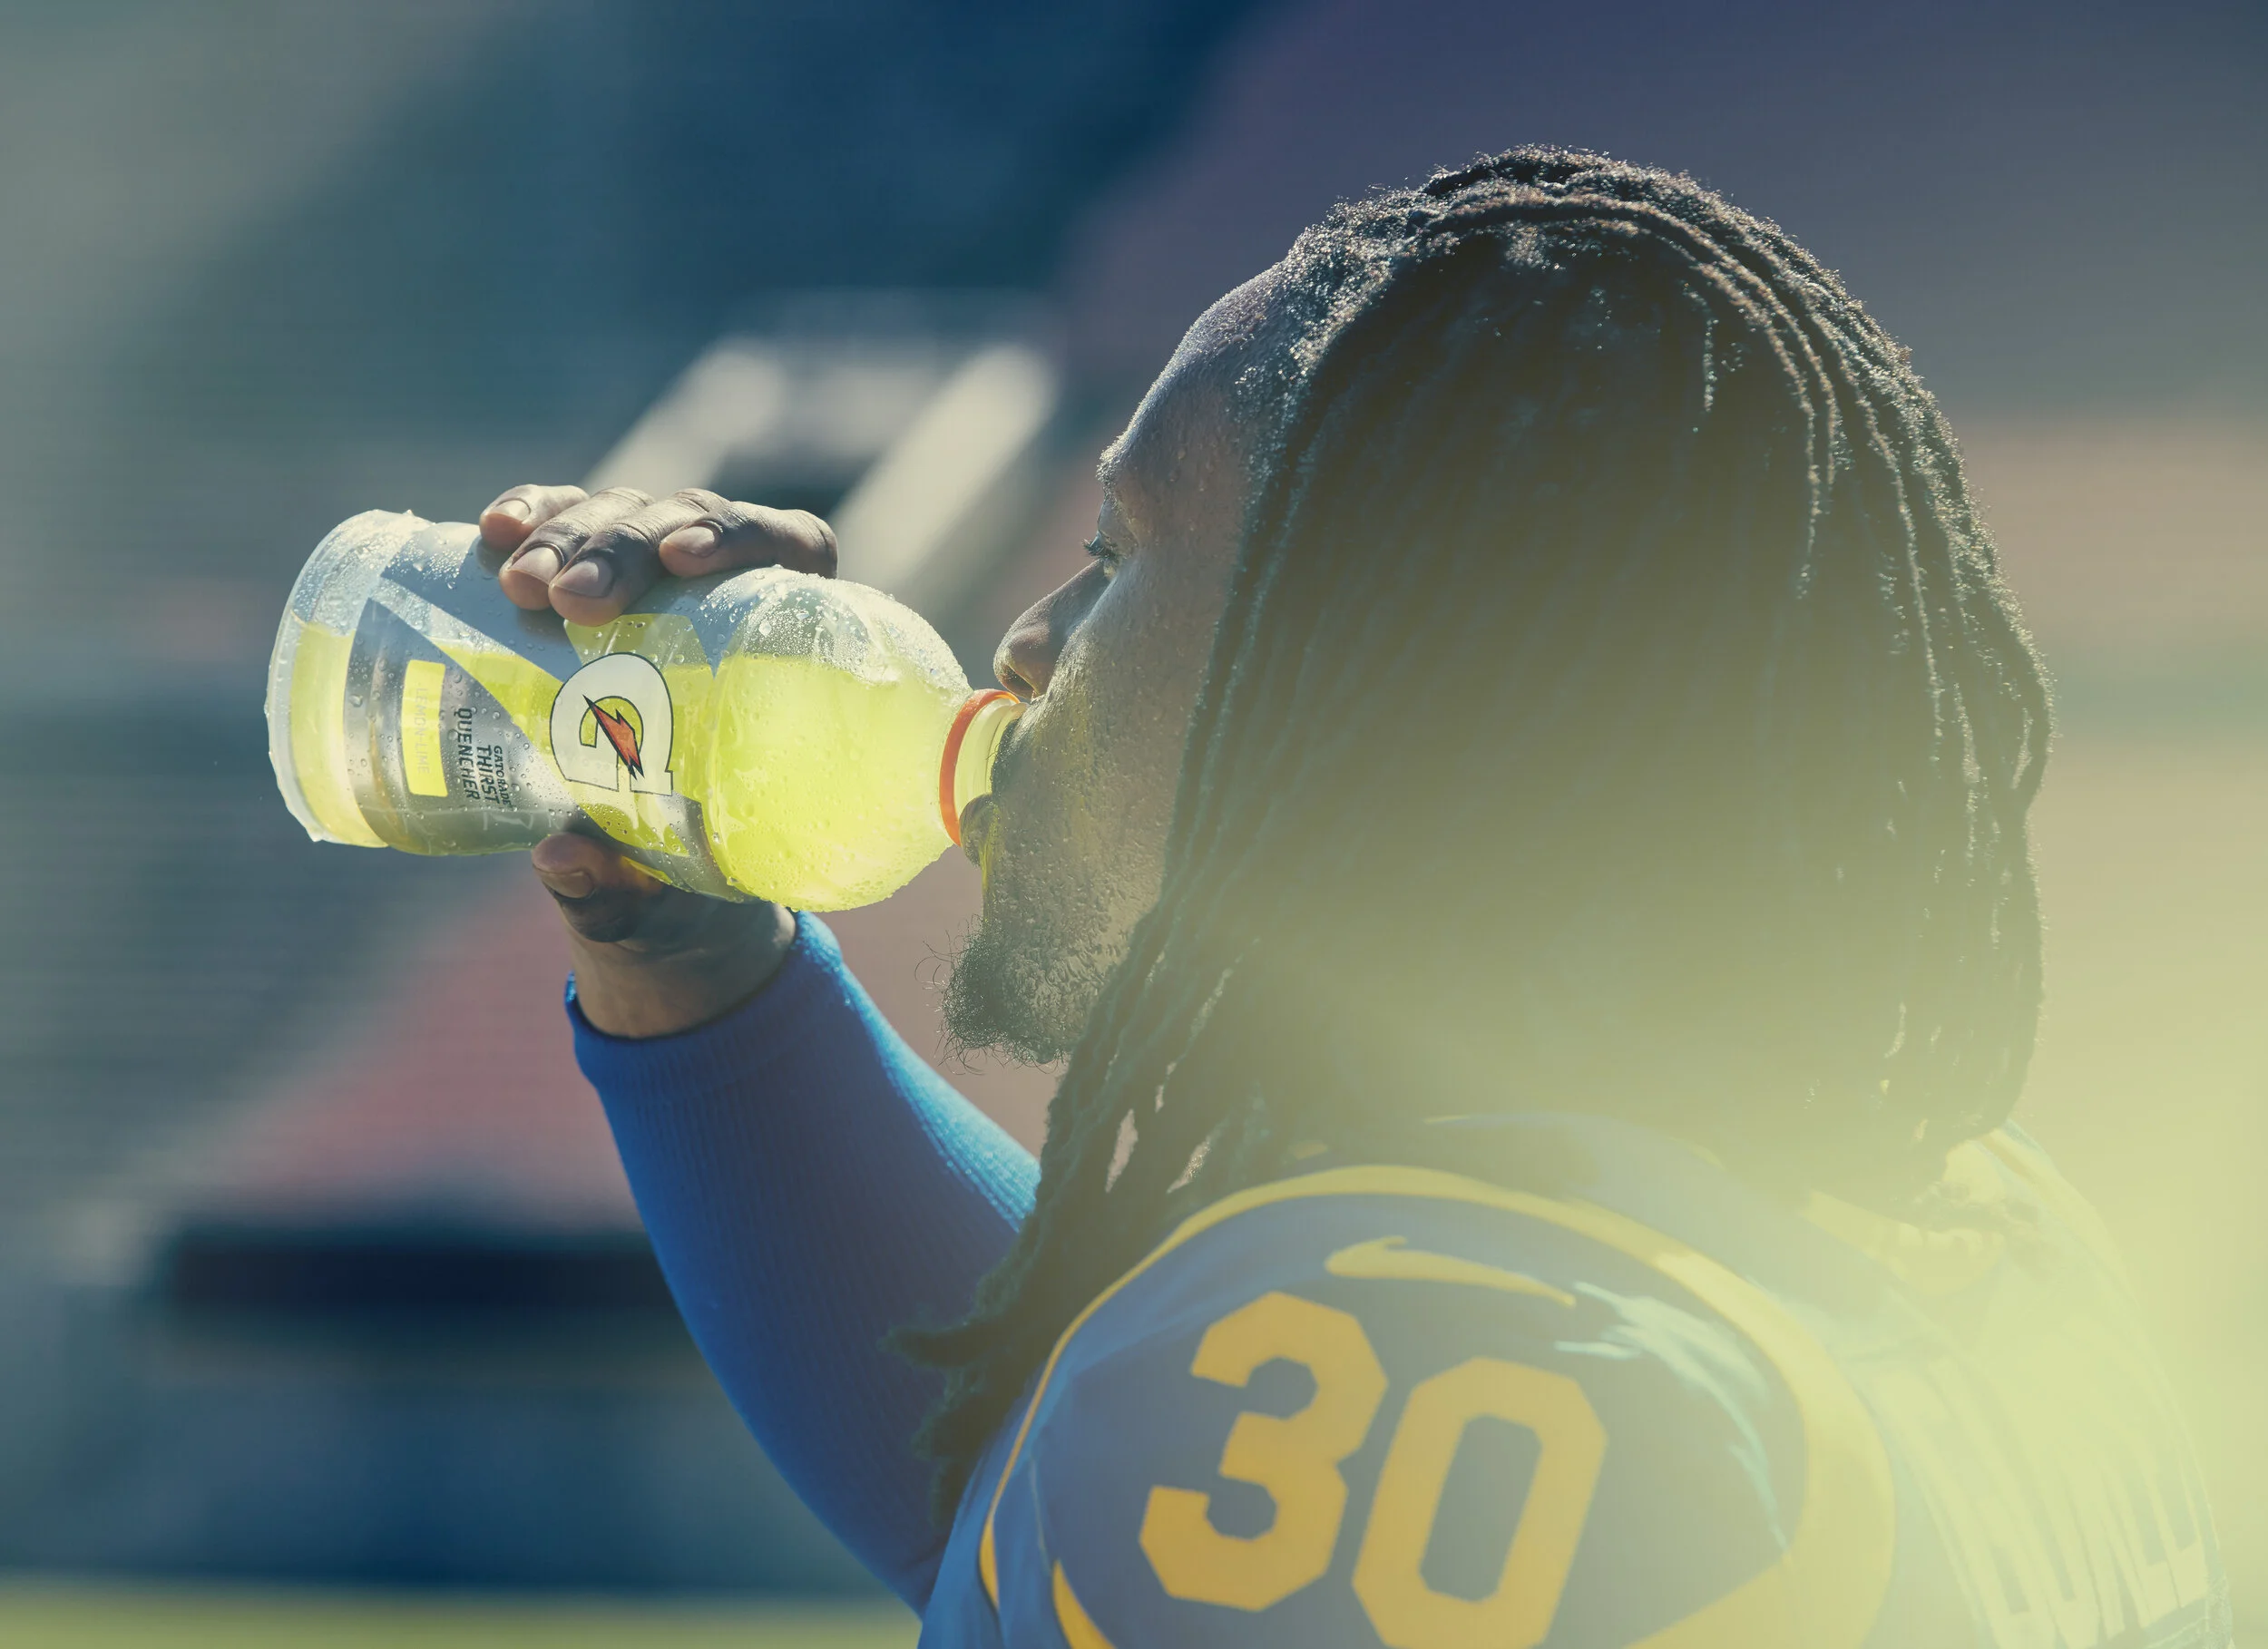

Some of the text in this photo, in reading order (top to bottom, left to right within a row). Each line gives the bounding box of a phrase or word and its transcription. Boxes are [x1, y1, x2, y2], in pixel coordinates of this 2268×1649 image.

[414, 688, 430, 774] LEMON-LIME
[454, 707, 481, 801] QUENCHER
[476, 745, 500, 804] THIRST
[494, 745, 513, 806] GATORADE
[1139, 1290, 1608, 1649] 30
